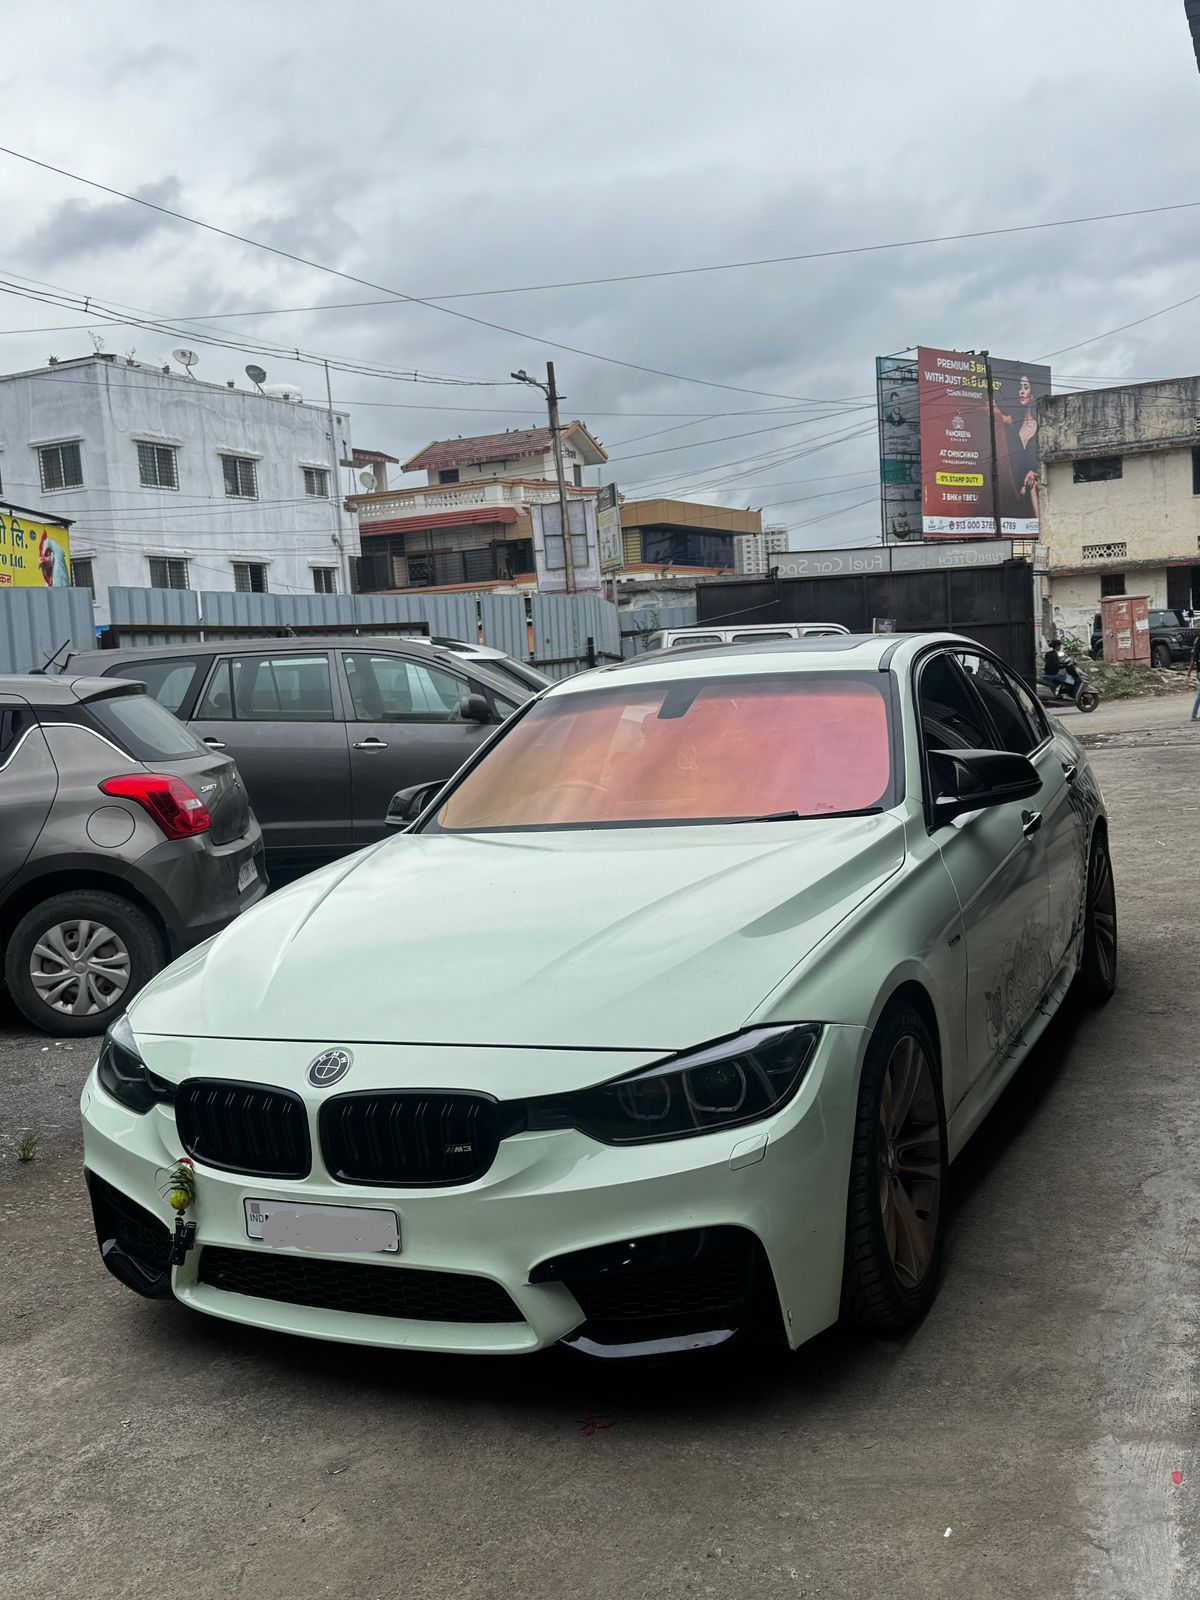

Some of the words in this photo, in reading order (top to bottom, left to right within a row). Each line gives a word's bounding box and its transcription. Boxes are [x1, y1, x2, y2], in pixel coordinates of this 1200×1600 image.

[937, 358, 969, 371] PREMIUM
[970, 360, 975, 371] 3
[976, 363, 987, 373] BH
[924, 371, 944, 383] WITH
[945, 374, 962, 386] JUST
[940, 449, 947, 457] AT
[949, 475, 965, 483] STAMP
[965, 476, 979, 484] DUTY
[955, 521, 966, 529] 913
[967, 521, 980, 529] 000
[10, 553, 26, 569] Ltd.
[249, 1212, 265, 1223] IND
